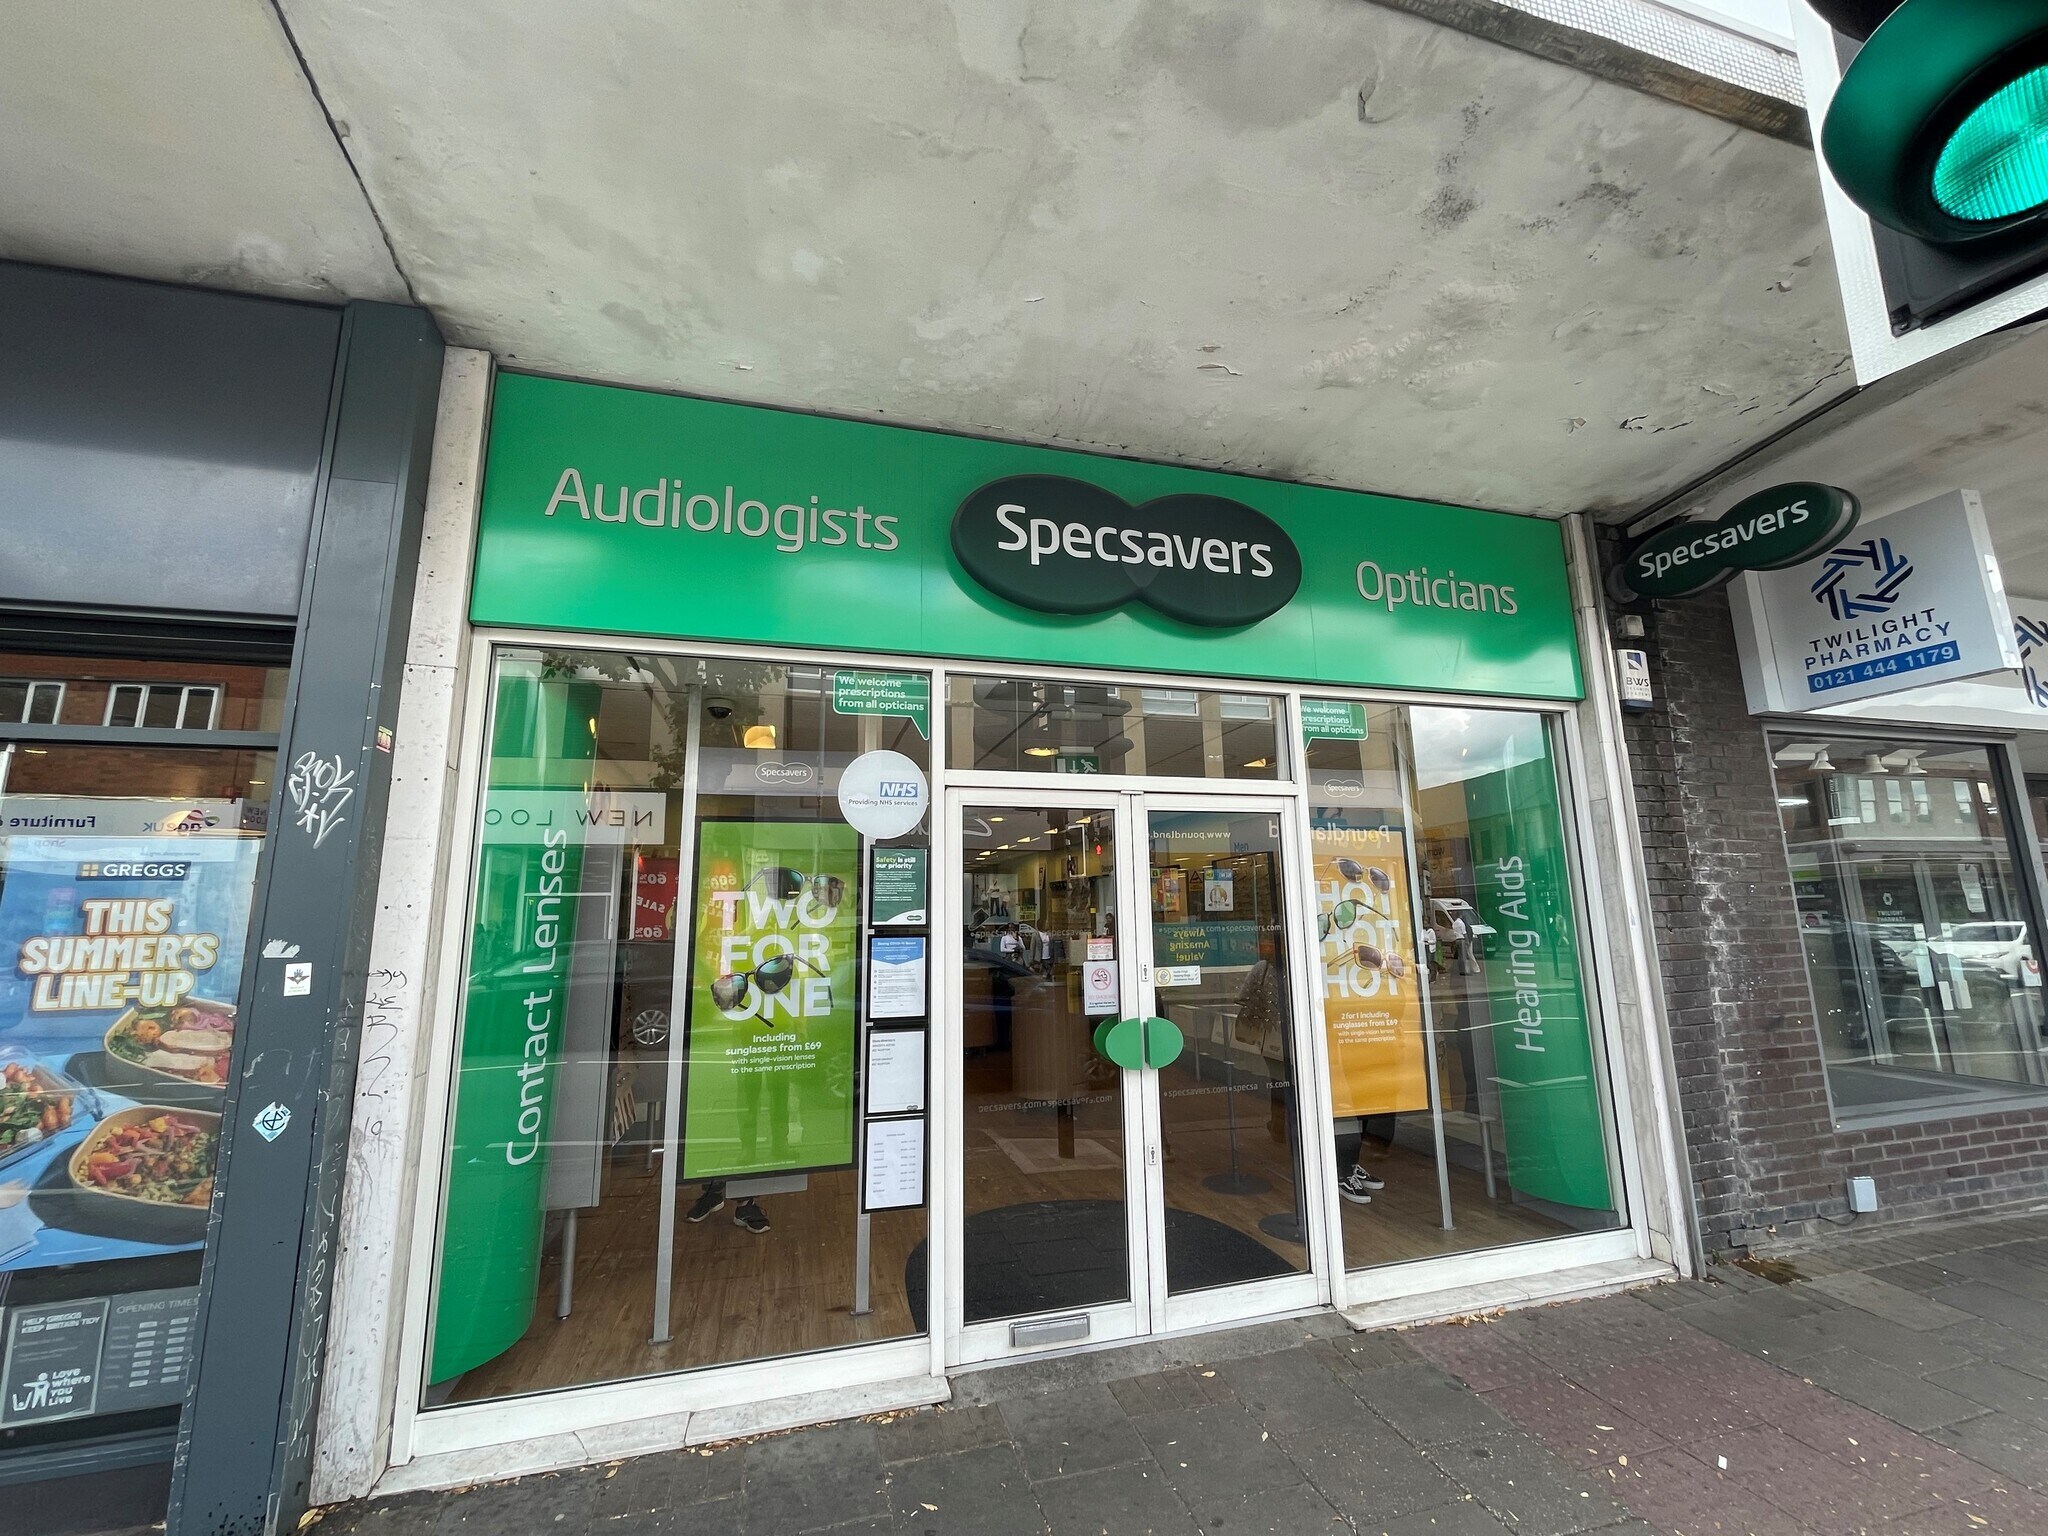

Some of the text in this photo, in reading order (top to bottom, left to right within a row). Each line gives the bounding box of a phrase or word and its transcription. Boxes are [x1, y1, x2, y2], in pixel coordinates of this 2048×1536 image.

[543, 466, 901, 554] Audiologists
[994, 502, 1276, 580] Specsavers
[1637, 498, 1811, 580] Specsavers
[1353, 560, 1520, 616] Opticians
[1808, 607, 1937, 653] TWILIGHT
[1803, 620, 1952, 672] PHARMACY
[1813, 645, 1955, 690] 0121 444 1179
[839, 675, 902, 687] We welcome
[1626, 676, 1650, 687] BWS
[838, 686, 906, 698] prescriptions
[838, 698, 925, 712] from all opticians
[1312, 705, 1346, 715] welcome
[1302, 724, 1364, 735] rom all opticians
[760, 766, 808, 778] Specsavers
[880, 782, 918, 798] NHS
[1327, 784, 1361, 793] Specsavers
[848, 798, 879, 807] Providing
[876, 856, 898, 864] Safety
[904, 856, 916, 864] still
[888, 861, 913, 870] priority
[102, 863, 187, 878] GREGGS
[83, 899, 173, 934] THIS
[712, 890, 838, 931] TWO
[21, 934, 220, 973] SUMMER'S
[719, 933, 832, 976] FOR
[1494, 855, 1546, 1053] Hearing Aids
[32, 970, 195, 1011] LINE-UP
[505, 828, 568, 1167] Contact Lenses
[1345, 1012, 1356, 1020] for
[1360, 1011, 1390, 1020] including
[1333, 1021, 1368, 1030] sunglasses
[1386, 1018, 1399, 1026] £69
[752, 1032, 797, 1044] Including
[725, 1041, 822, 1057] sunglasses from £69
[731, 1052, 816, 1066] with single-vision lenses
[730, 1061, 816, 1075] to the same prescription
[1167, 1079, 1290, 1099] specsavers.com specsars.com
[116, 1298, 199, 1315] OPENING TIMES
[22, 1311, 82, 1327] HELP GREGGS
[81, 1316, 101, 1326] TIDY
